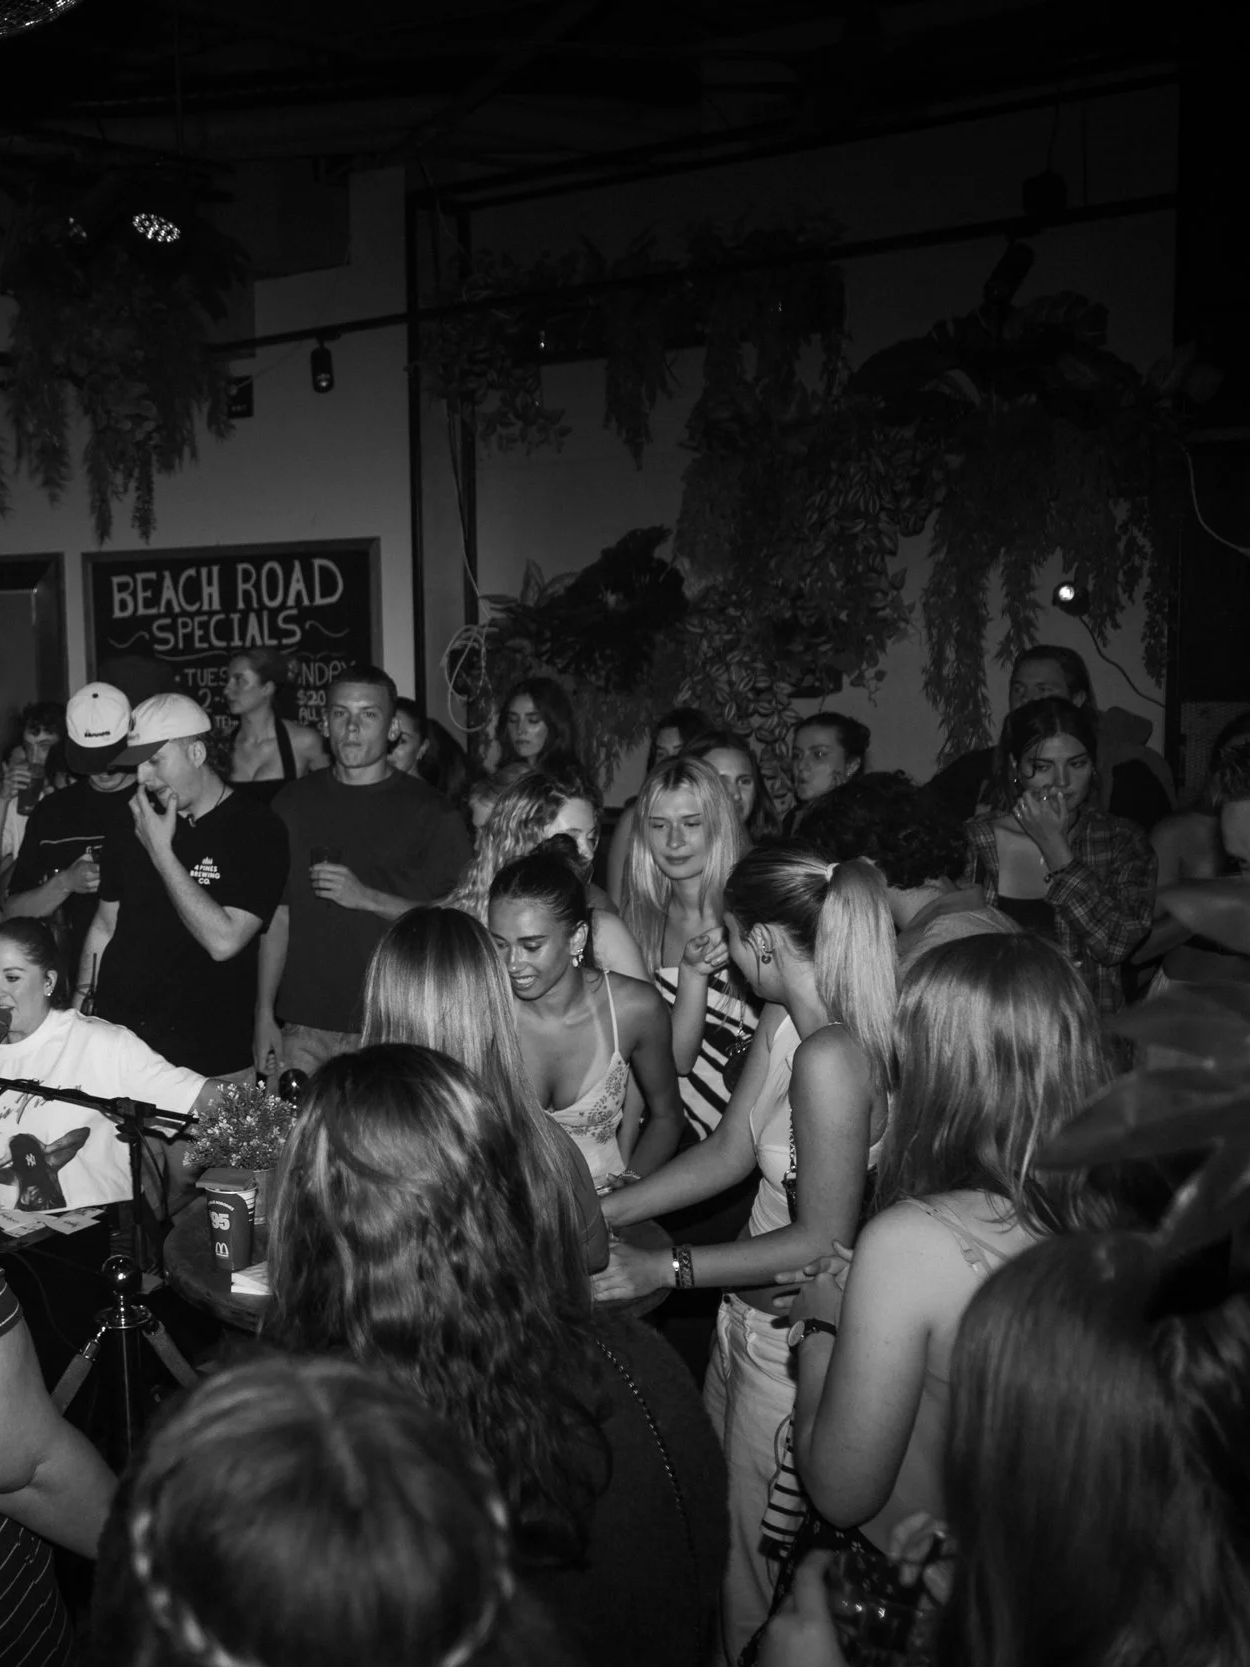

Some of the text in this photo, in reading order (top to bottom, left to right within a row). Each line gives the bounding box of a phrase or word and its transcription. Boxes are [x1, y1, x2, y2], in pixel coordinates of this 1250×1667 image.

[110, 557, 345, 619] BEACH ROAD
[151, 607, 303, 651] SPECIALS
[190, 870, 220, 880] BREWING
[199, 864, 218, 873] PINES
